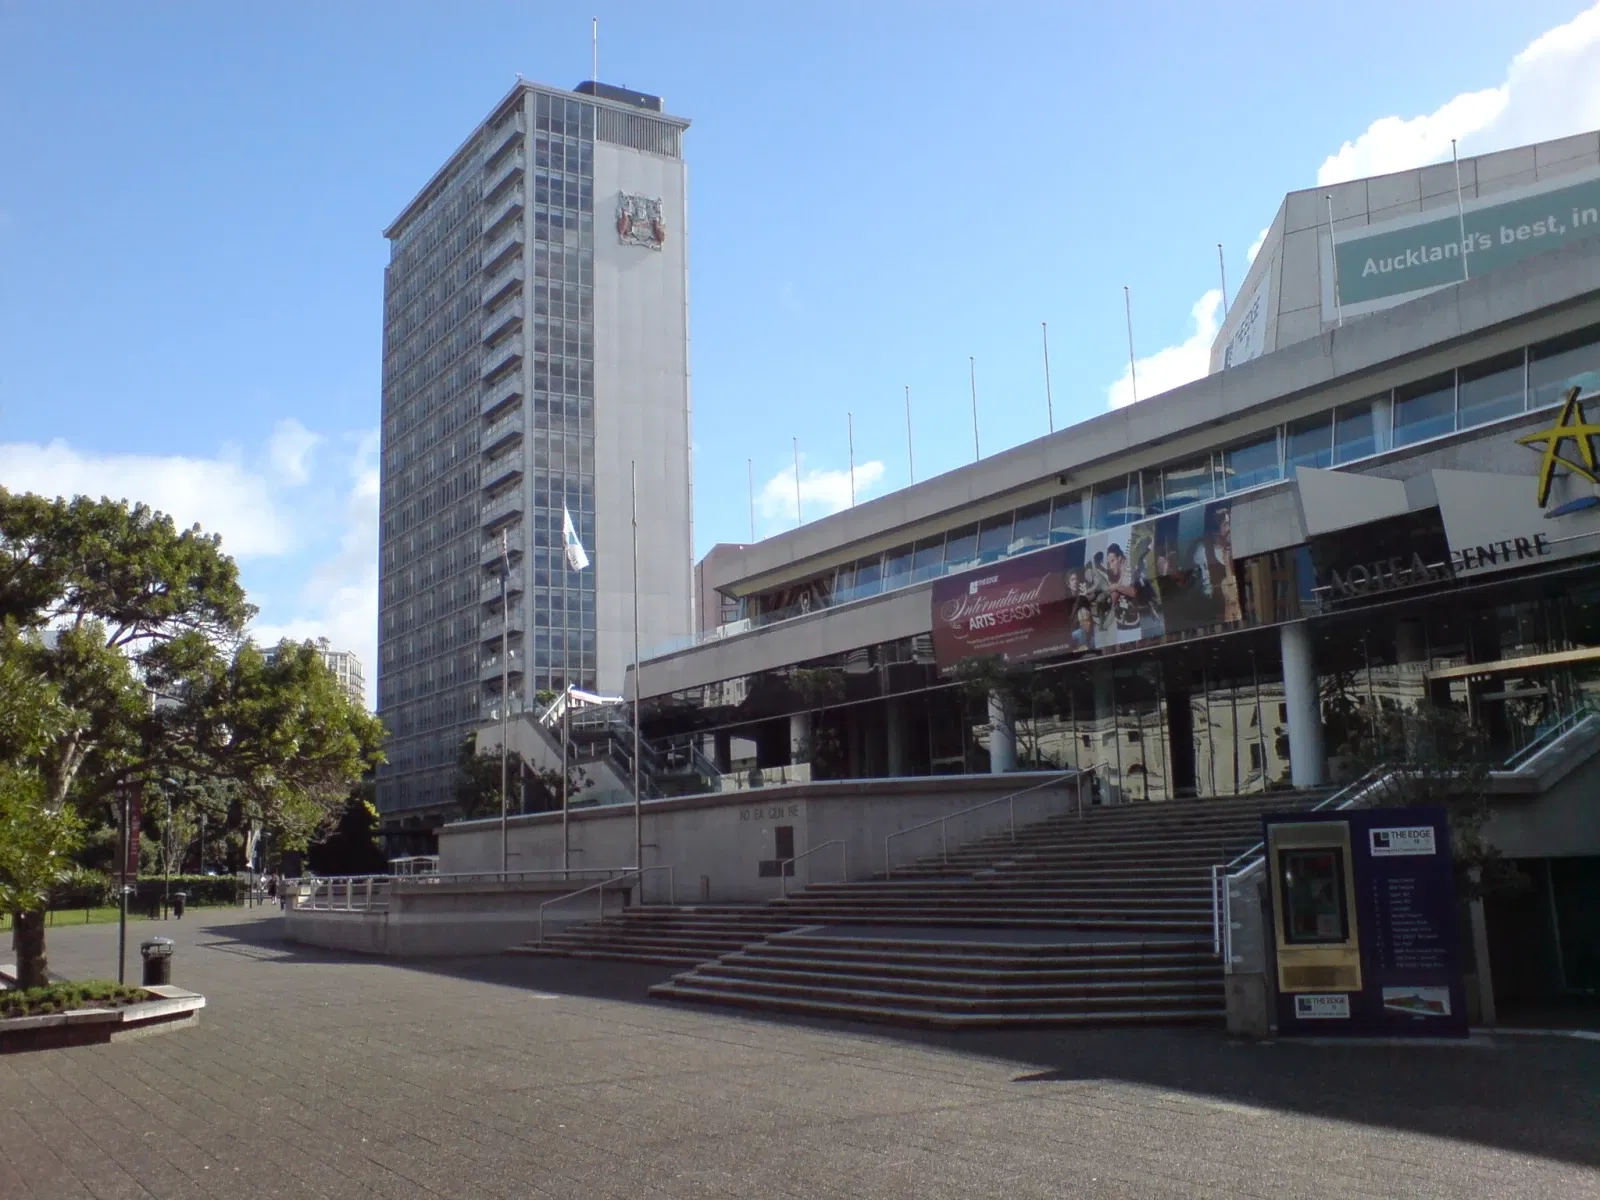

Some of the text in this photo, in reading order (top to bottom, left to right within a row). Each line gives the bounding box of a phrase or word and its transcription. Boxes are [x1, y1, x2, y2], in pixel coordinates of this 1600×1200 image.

[1361, 206, 1599, 278] Auckland's best, in
[1449, 532, 1552, 573] CENTRE
[940, 571, 1051, 622] International
[969, 602, 1041, 632] ARTS SEASON
[1391, 829, 1432, 839] THE EDGE
